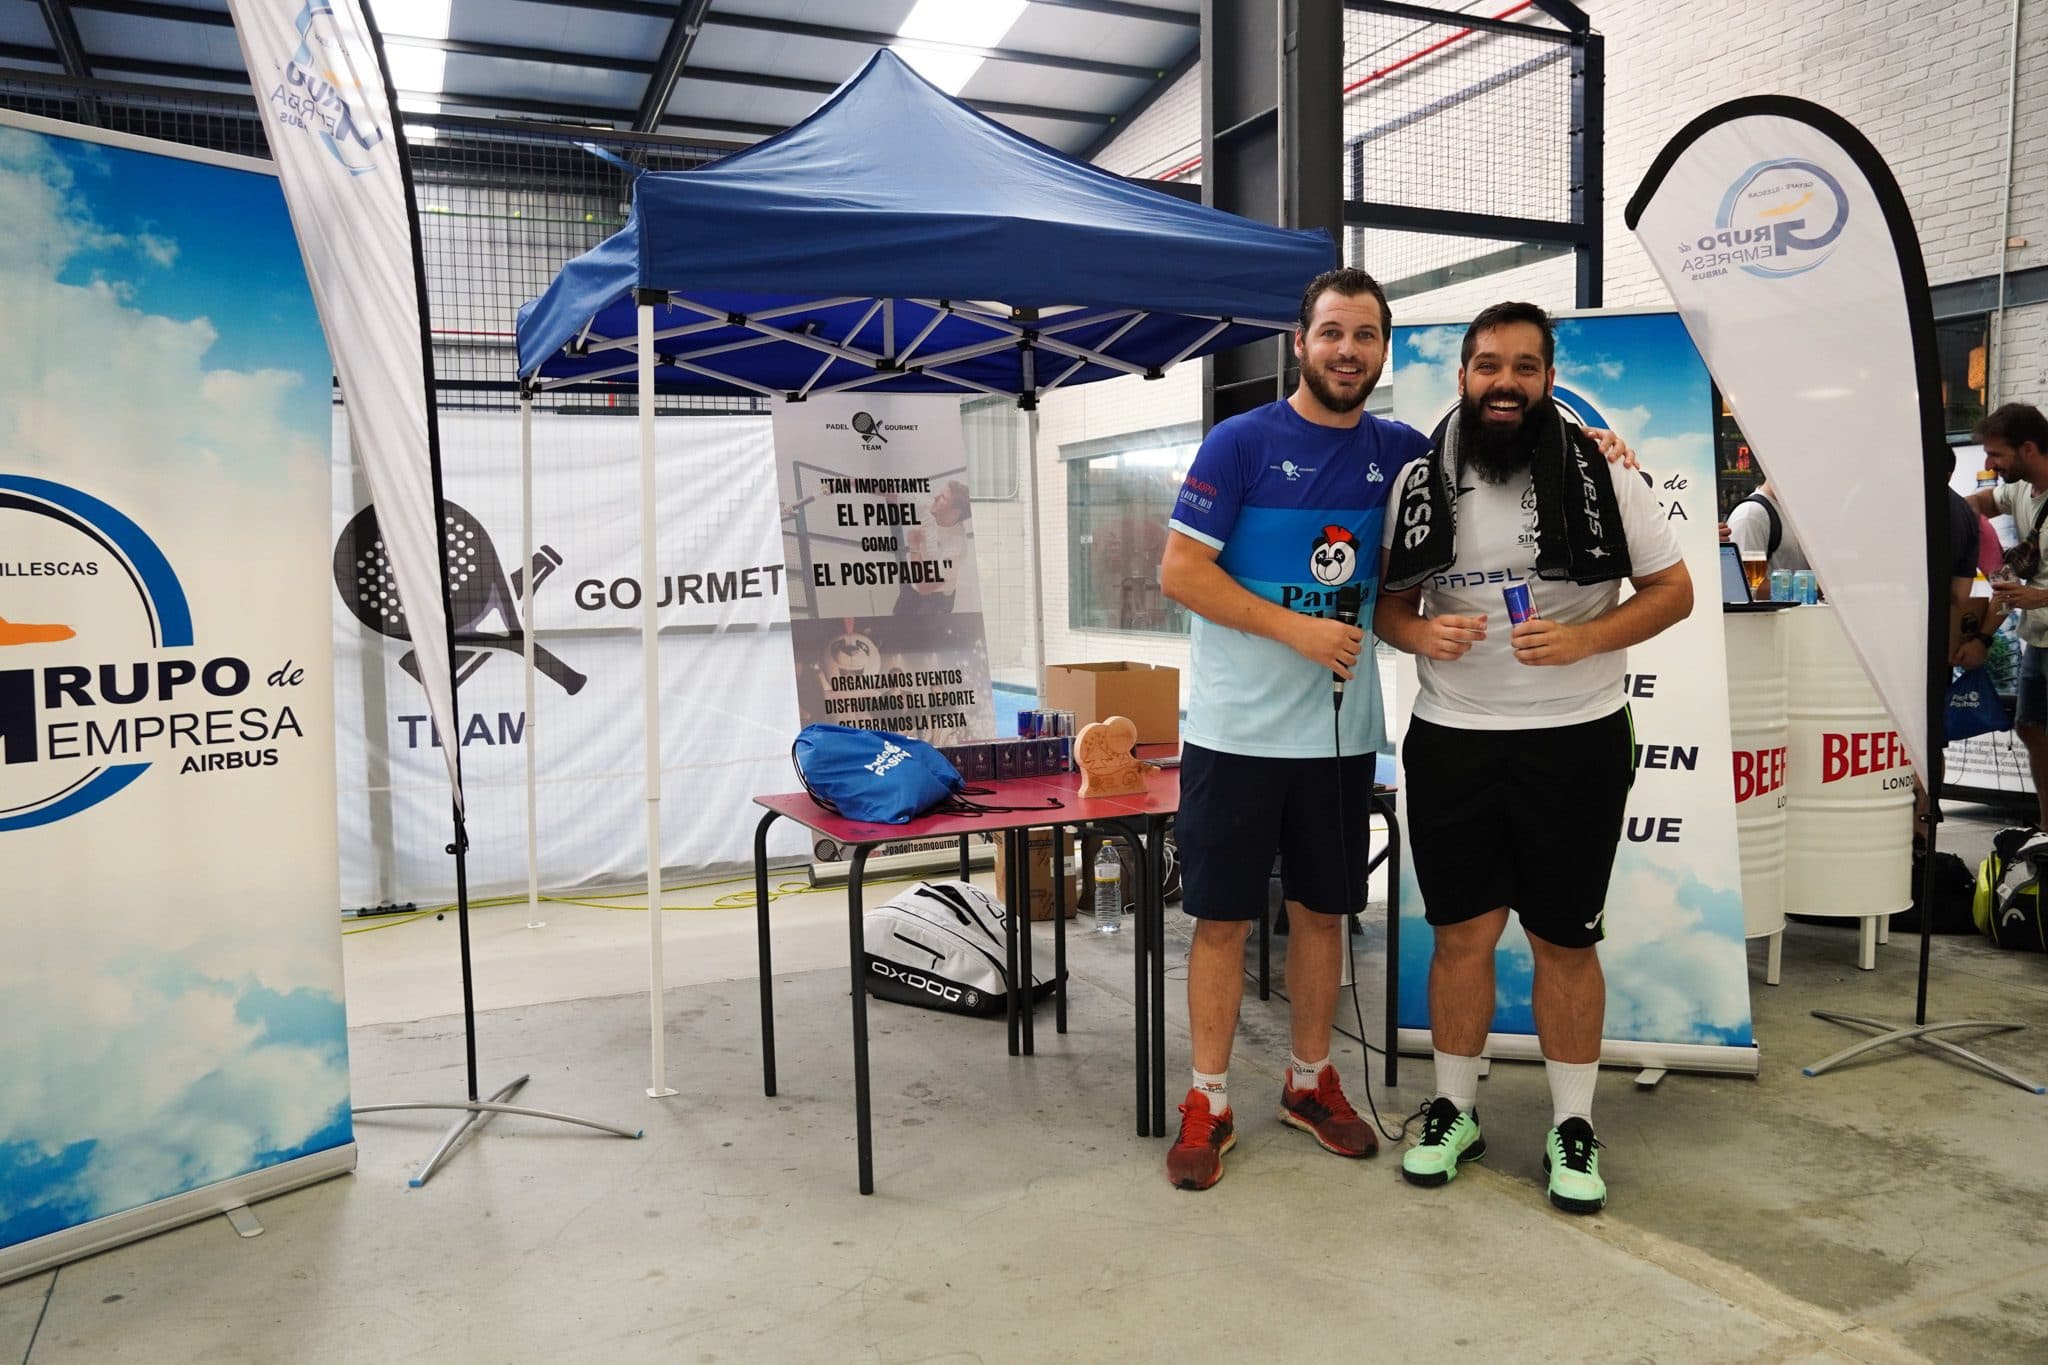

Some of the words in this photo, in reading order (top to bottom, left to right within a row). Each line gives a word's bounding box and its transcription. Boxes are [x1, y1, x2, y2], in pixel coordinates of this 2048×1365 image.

[855, 478, 931, 494] IMPORTANTE
[1663, 473, 1688, 490] de
[837, 503, 858, 527] EL
[863, 503, 921, 526] PADEL
[861, 536, 898, 552] COMO
[813, 563, 836, 587] EL
[44, 657, 250, 709] RUPO
[267, 659, 304, 687] de
[831, 671, 913, 692] ORGANIZAMOS
[915, 669, 962, 687] EVENTOS
[825, 694, 904, 714] DISFRUTAMOS
[906, 692, 927, 709] DEL
[929, 690, 976, 707] DEPORTE
[48, 706, 303, 760] EMPRESA
[916, 715, 929, 730] LA
[931, 713, 967, 729] FIESTA
[180, 749, 278, 774] AIRBUS
[872, 961, 962, 1002] OXDOG
